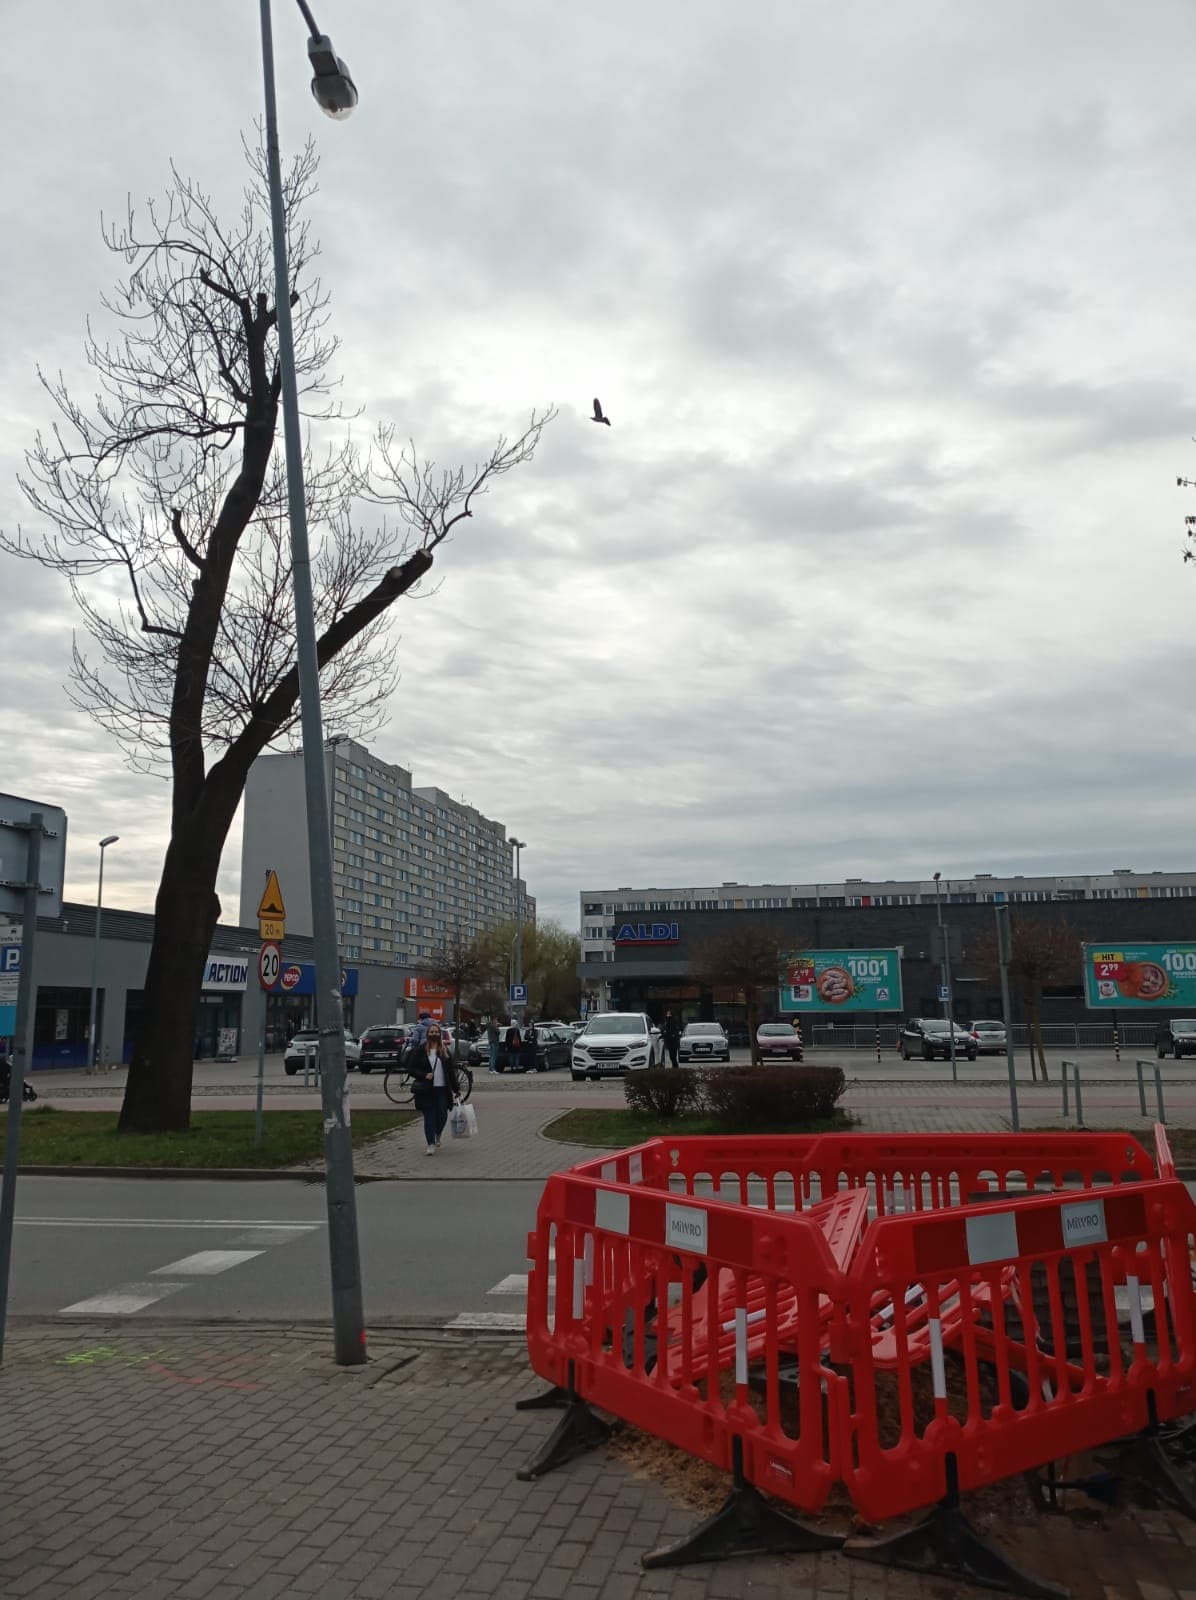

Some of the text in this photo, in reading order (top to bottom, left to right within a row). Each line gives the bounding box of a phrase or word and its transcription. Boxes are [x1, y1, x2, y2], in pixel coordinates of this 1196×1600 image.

[265, 923, 274, 935] 20
[616, 923, 679, 940] ALDI
[6, 949, 20, 971] P
[263, 954, 278, 976] 20
[1102, 953, 1114, 961] HIT
[208, 963, 248, 983] ACTION
[848, 959, 888, 976] 1001
[514, 986, 524, 1000] P
[941, 986, 949, 997] P
